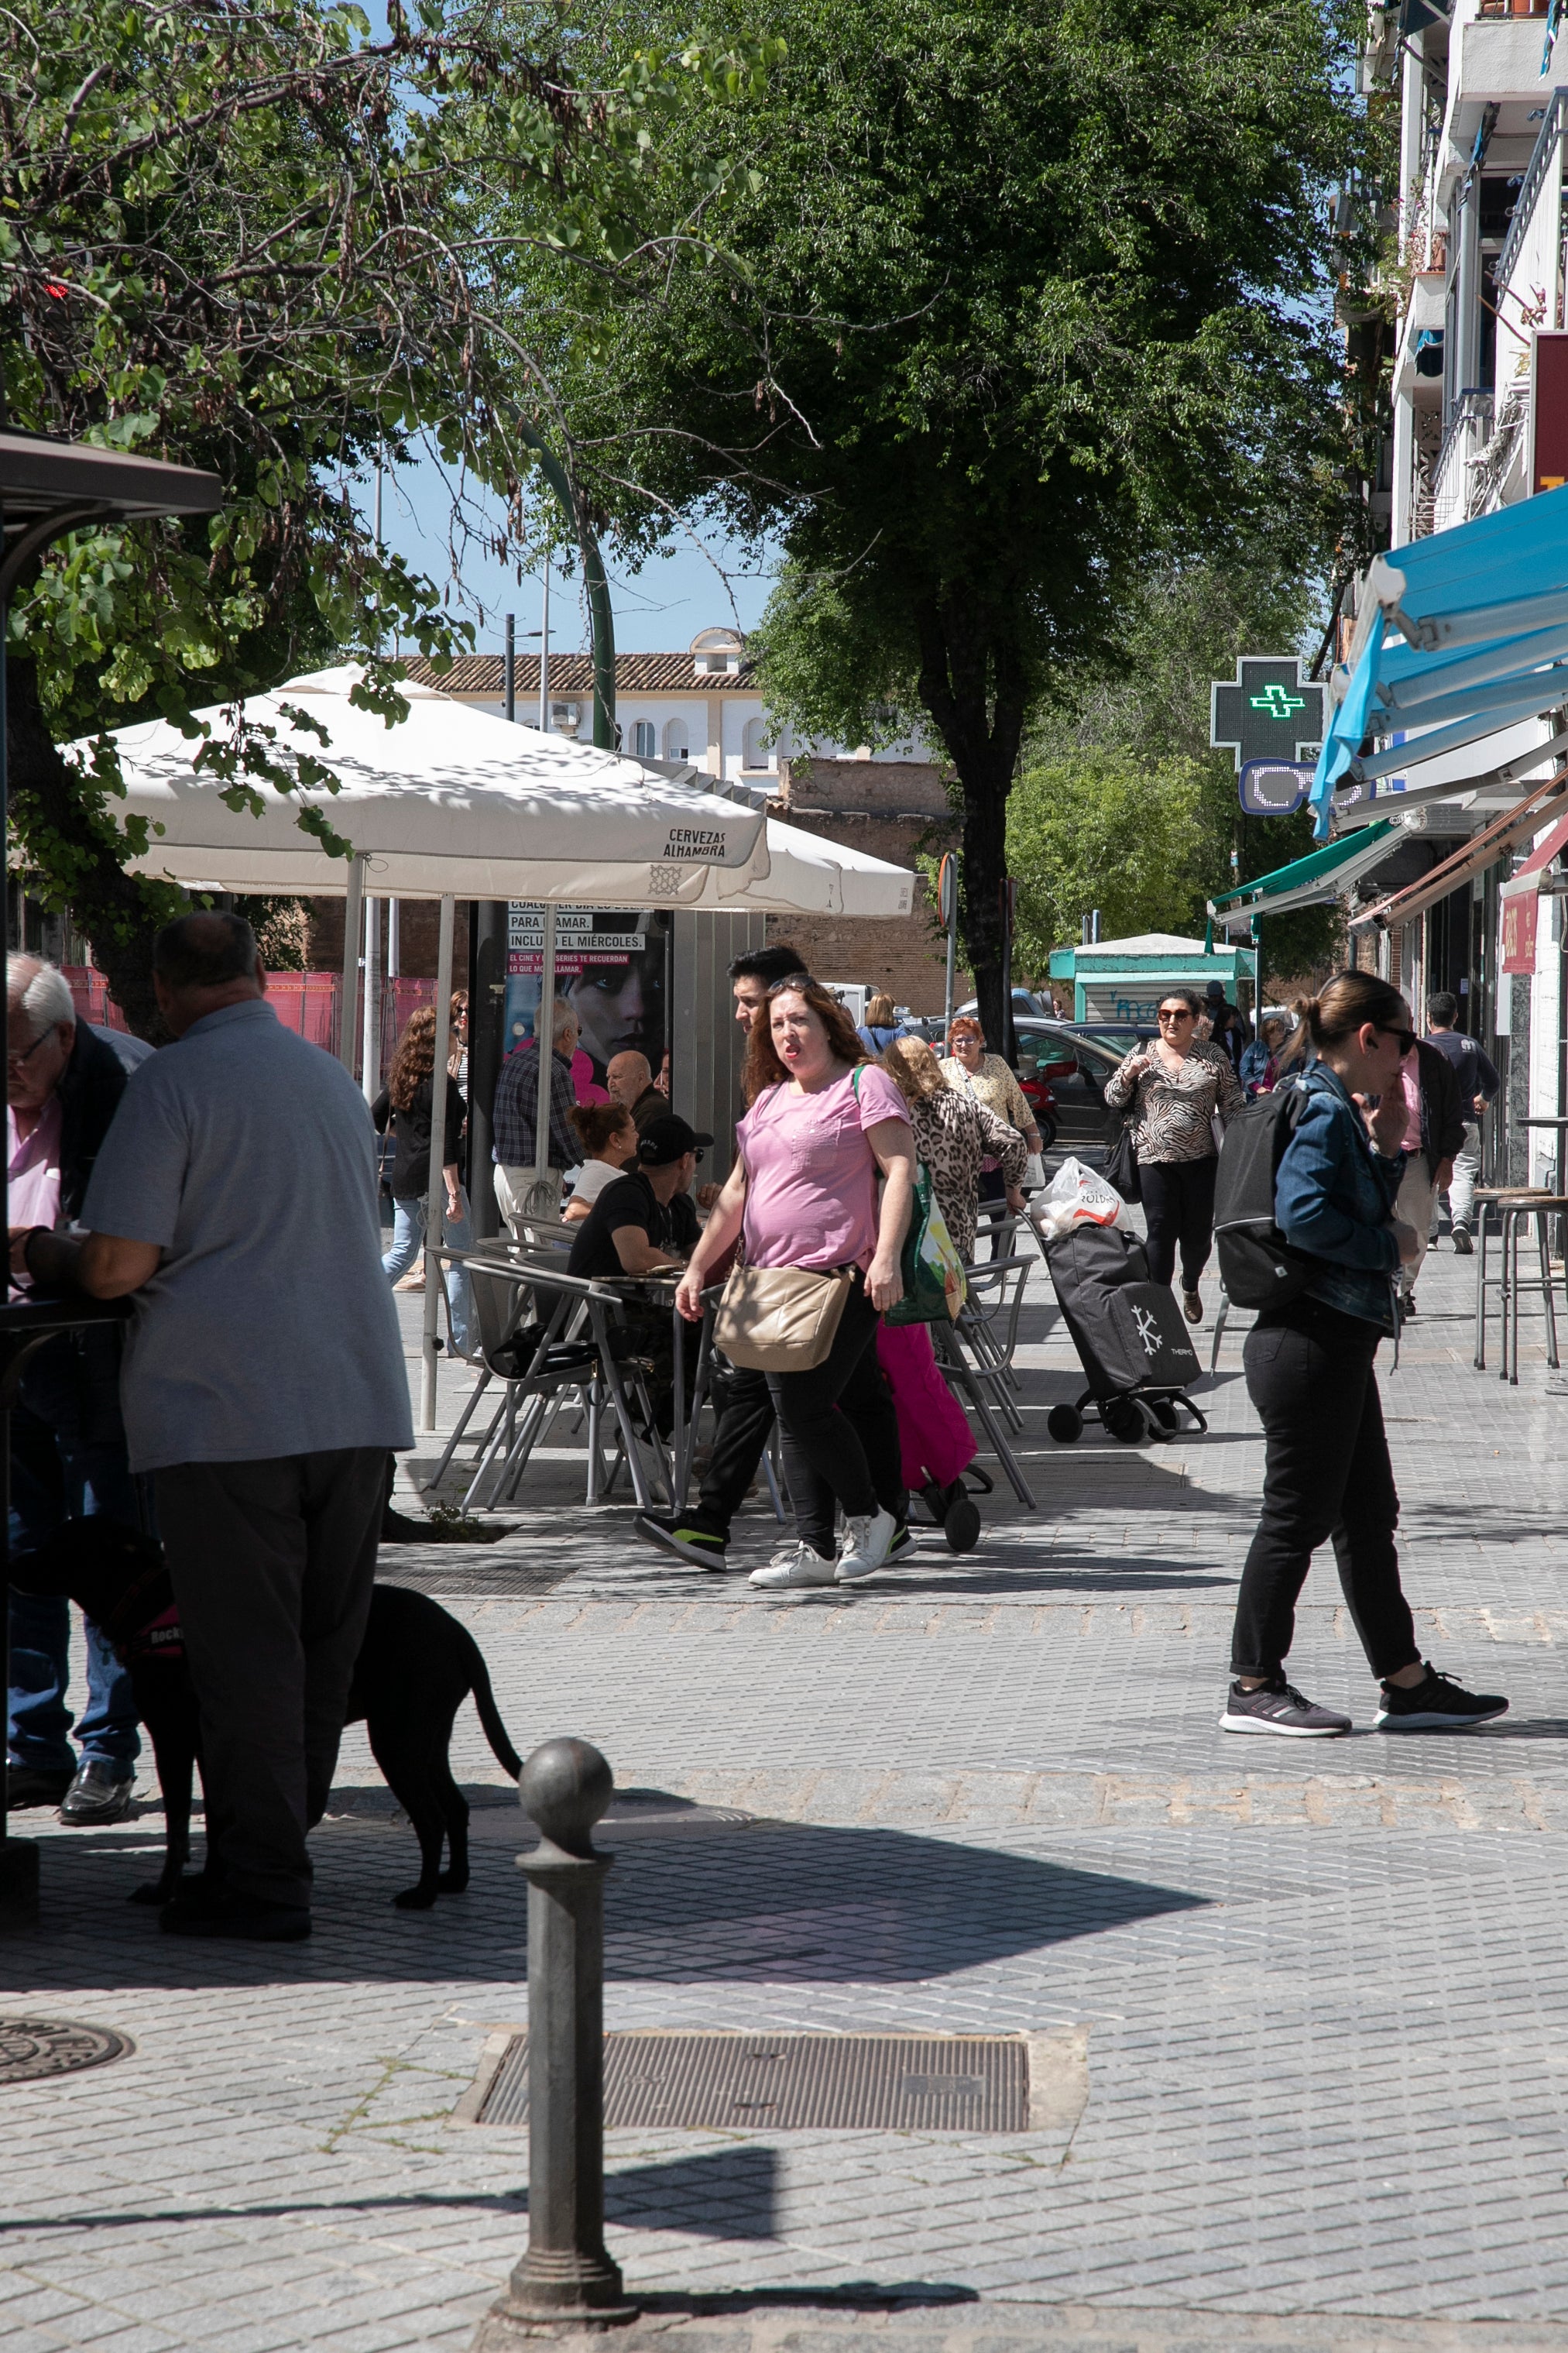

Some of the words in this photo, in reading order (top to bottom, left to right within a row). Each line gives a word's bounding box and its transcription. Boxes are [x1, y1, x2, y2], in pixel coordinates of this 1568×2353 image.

[669, 829, 726, 844] CERVEZAS
[663, 843, 725, 857] ALHAMBRA
[511, 917, 540, 927] PARA
[561, 936, 574, 946] EL
[578, 934, 642, 947] MIÉRCOLES.
